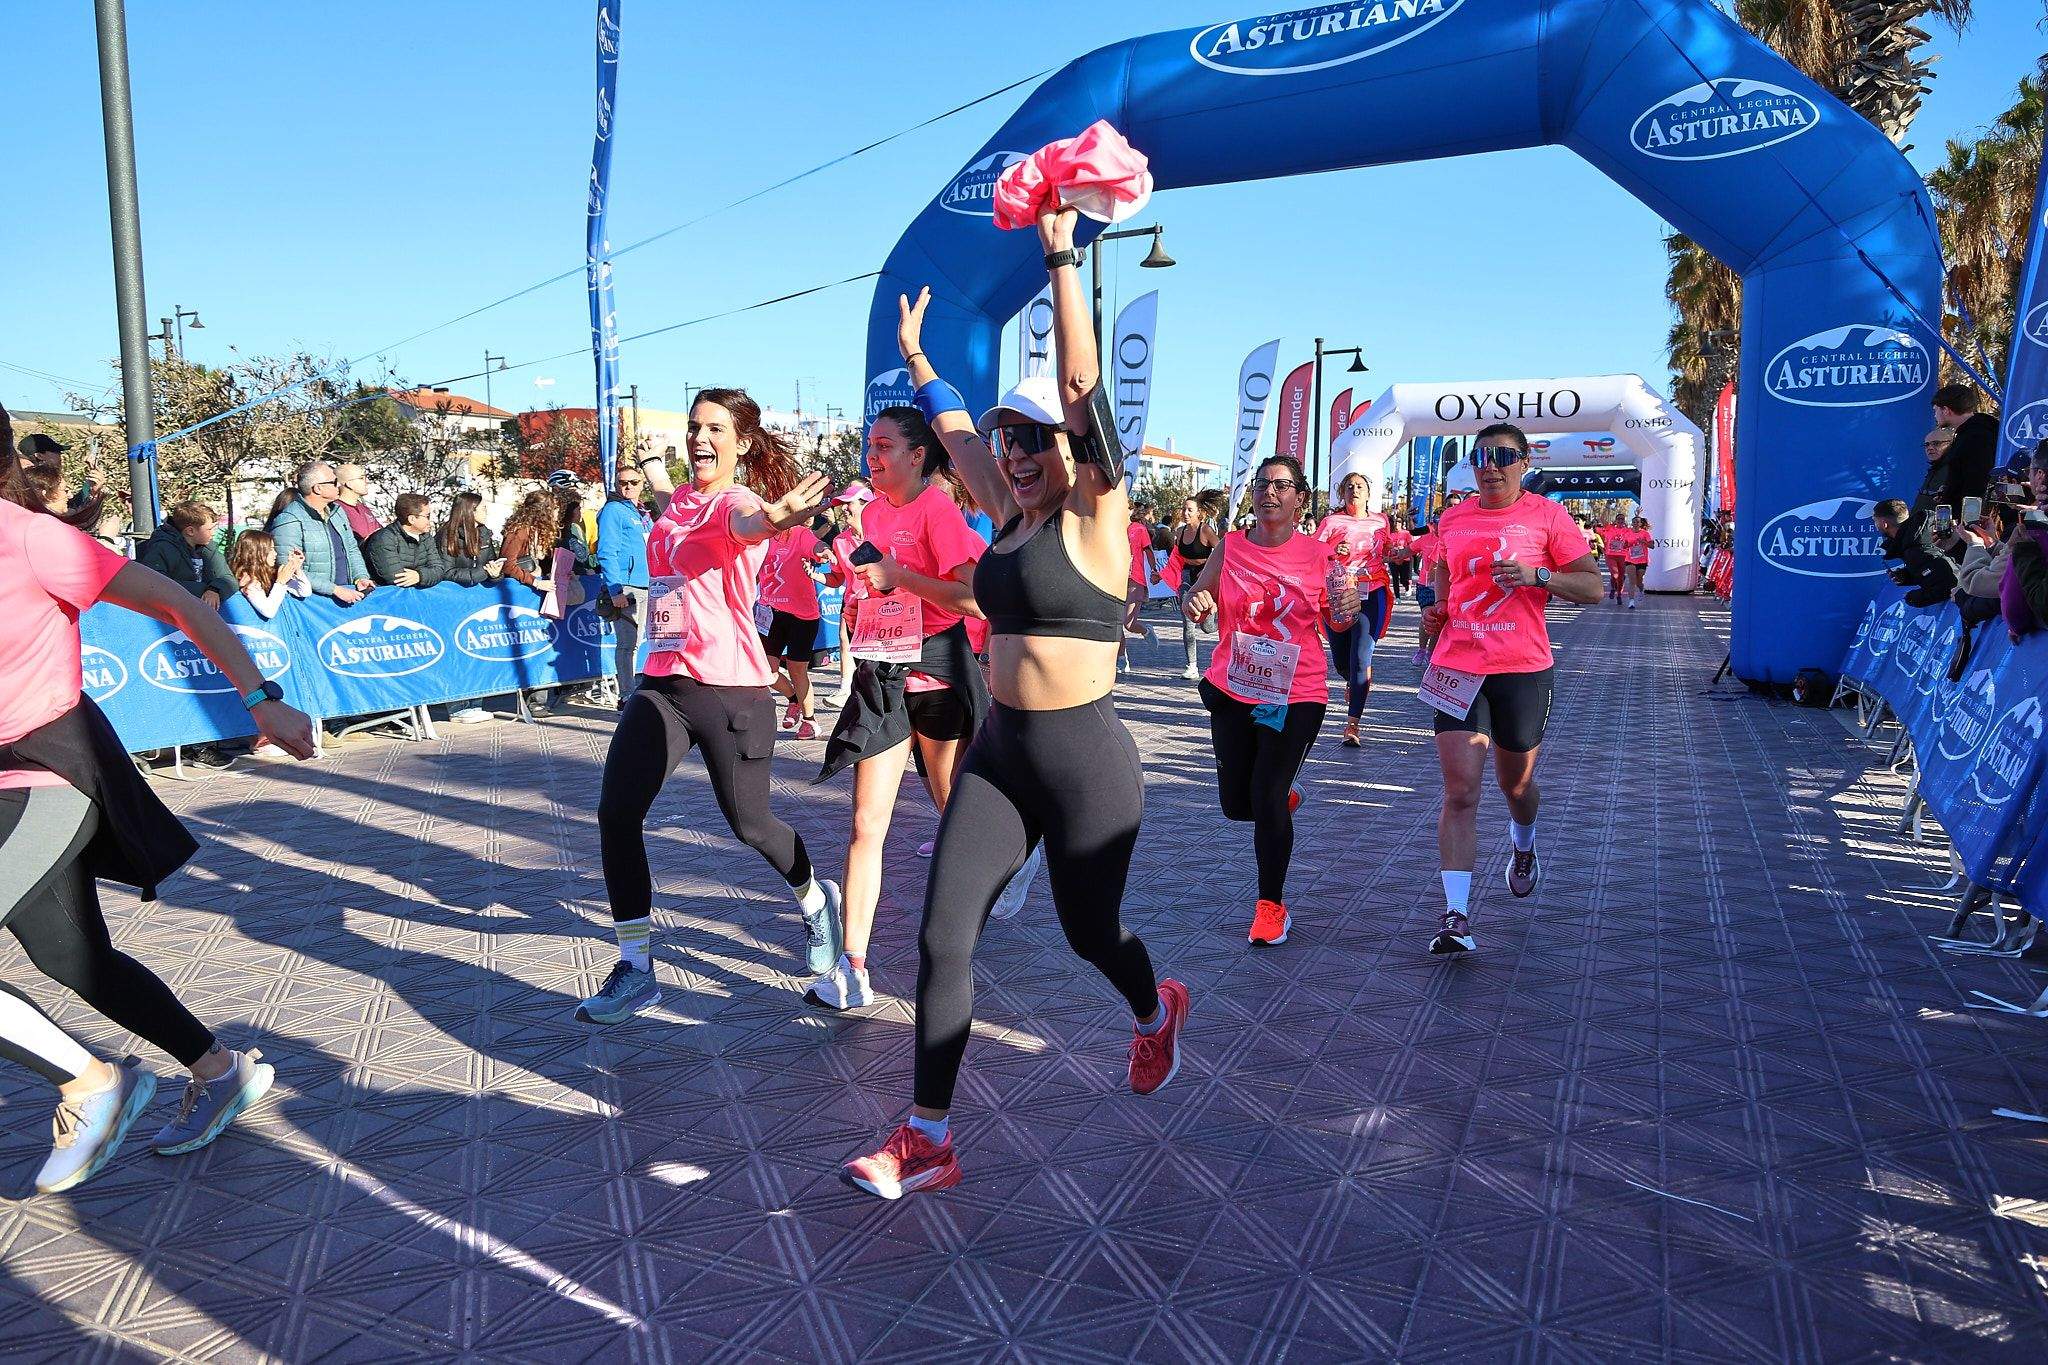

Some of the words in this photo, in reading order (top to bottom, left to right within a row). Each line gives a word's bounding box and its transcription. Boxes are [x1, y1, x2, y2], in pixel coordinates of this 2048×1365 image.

[1207, 0, 1445, 58] ASTURIANA
[1671, 106, 1732, 121] CENTRAL
[1738, 98, 1798, 110] LECHERA
[1644, 107, 1808, 149] ASTURIANA
[1801, 353, 1863, 365] CENTRAL
[1869, 351, 1921, 361] LECHERA
[1774, 360, 1923, 391] ASTURIANA
[1435, 389, 1581, 422] OYSHO
[1625, 418, 1673, 429] OYSHO
[1352, 428, 1393, 437] OYSHO
[1555, 476, 1624, 484] VOLVO
[1793, 525, 1854, 534] CENTRAL
[478, 624, 509, 632] CENTRAL
[877, 626, 903, 639] 016
[1470, 622, 1480, 631] DE
[1491, 622, 1516, 632] MUJER
[346, 635, 387, 645] CENTRAL
[391, 632, 429, 642] LECHERA
[467, 628, 551, 651] ASTURIANA
[329, 640, 438, 667] ASTURIANA
[1247, 663, 1273, 678] 016
[1437, 671, 1460, 689] 016
